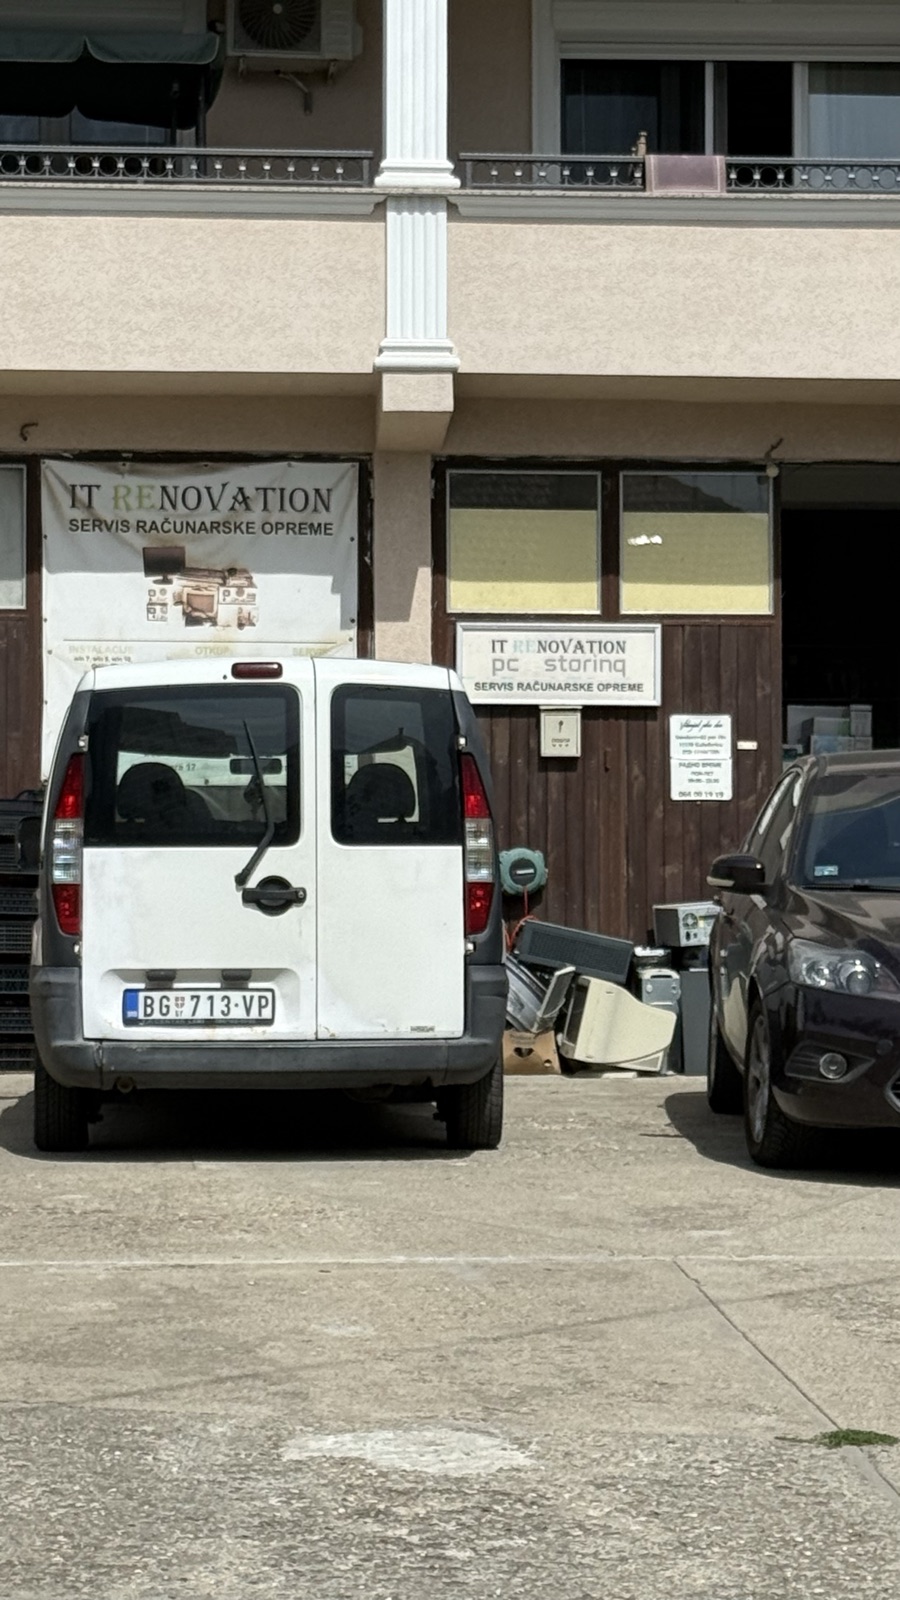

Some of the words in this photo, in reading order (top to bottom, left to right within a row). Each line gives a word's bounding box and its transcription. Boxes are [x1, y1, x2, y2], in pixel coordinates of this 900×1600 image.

[69, 484, 101, 509] IT
[113, 482, 332, 513] RENOVATION
[69, 519, 130, 533] SERVIS
[136, 518, 256, 535] RAČUNARSKE
[261, 522, 334, 536] OPREME
[491, 639, 508, 654] IT
[513, 638, 627, 655] RENOVATION
[492, 657, 519, 676] pc
[474, 682, 514, 693] SERVIS
[517, 680, 594, 693] RAČUNARSKE
[597, 682, 645, 693] OPREME
[143, 995, 171, 1017] BG
